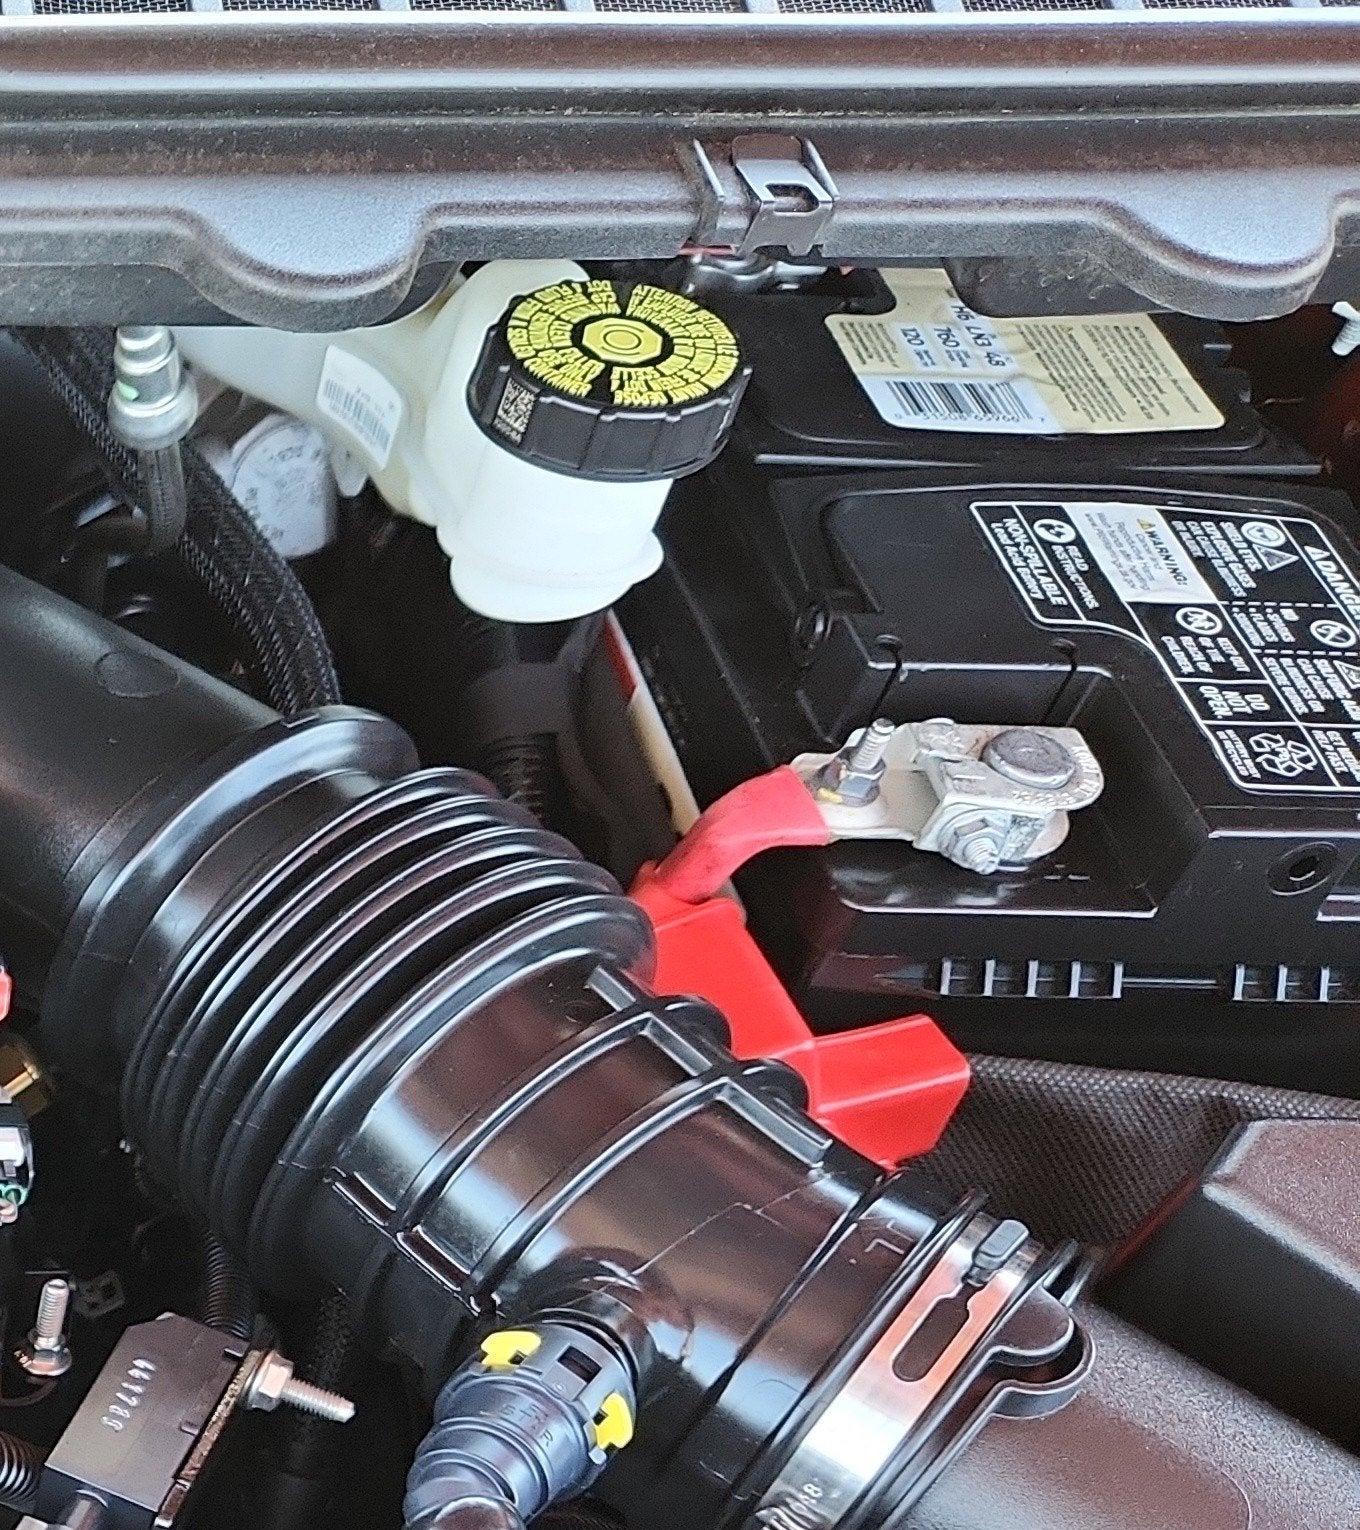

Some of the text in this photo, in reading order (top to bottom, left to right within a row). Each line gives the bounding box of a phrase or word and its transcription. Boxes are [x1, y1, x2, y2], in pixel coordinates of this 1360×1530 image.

[633, 284, 699, 311] ATTENTION
[899, 328, 926, 345] 120
[931, 326, 963, 348] 760
[949, 305, 975, 320] H6
[963, 325, 994, 347] LN3
[981, 351, 1007, 367] 48
[523, 357, 592, 398] CONTAINER
[988, 523, 1048, 599] Lead Acid Battery
[1003, 517, 1067, 606] NON-SPILLABLE
[1063, 545, 1093, 570] READ
[1148, 530, 1189, 586] WARNING:
[1315, 560, 1360, 624] DANGE
[1195, 685, 1235, 718] OPEN.
[1220, 691, 1252, 713] NOT
[1242, 694, 1271, 710] DO
[1310, 730, 1334, 750] HELP
